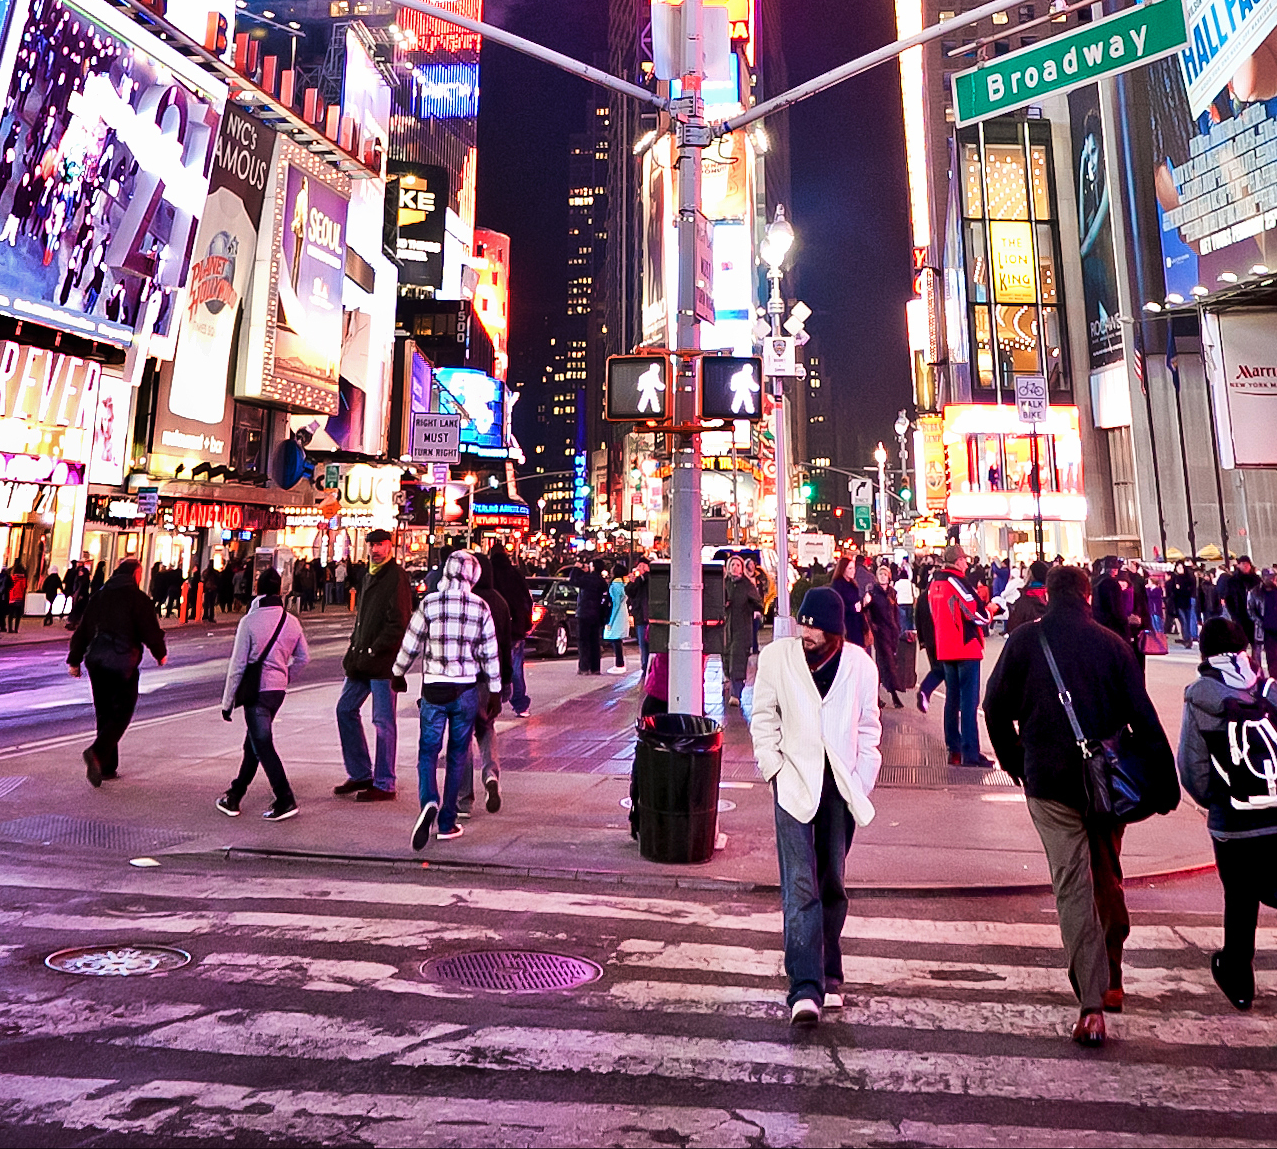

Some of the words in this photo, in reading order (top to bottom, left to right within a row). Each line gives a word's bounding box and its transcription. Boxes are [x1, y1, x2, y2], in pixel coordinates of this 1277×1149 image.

[1183, 2, 1229, 87] HALL
[985, 22, 1148, 102] Broadway
[226, 112, 258, 150] NYC's
[308, 206, 343, 255] SEOUL
[1001, 237, 1022, 248] THE
[997, 252, 1028, 269] LION
[999, 272, 1031, 291] KING
[1020, 400, 1043, 409] WALK
[415, 418, 438, 428] RIGHT
[439, 418, 458, 428] LANE
[1022, 411, 1042, 419] BIKE
[423, 433, 449, 443] MUST
[413, 448, 434, 457] TURN
[435, 448, 458, 458] RIGHT
[173, 501, 221, 528] PLANET
